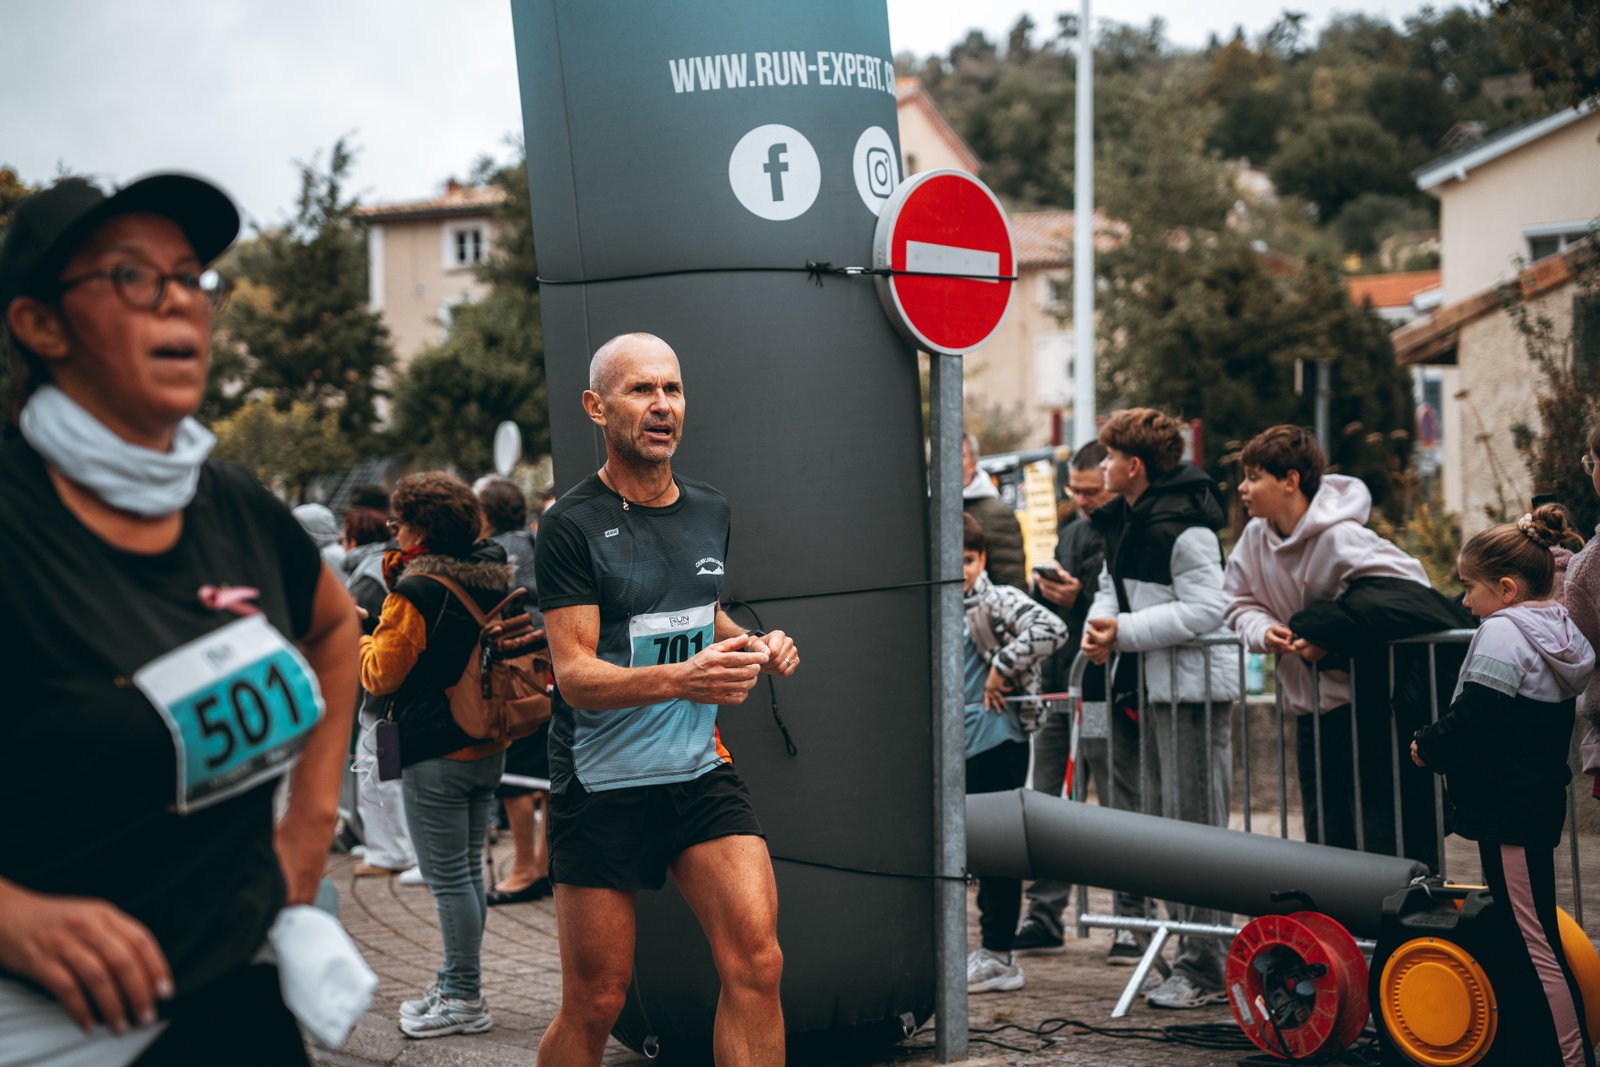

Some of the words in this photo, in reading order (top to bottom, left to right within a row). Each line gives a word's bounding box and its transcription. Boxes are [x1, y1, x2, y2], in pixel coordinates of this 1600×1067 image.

[669, 615, 689, 624] RUN
[654, 631, 703, 665] 701
[195, 664, 299, 768] 501
